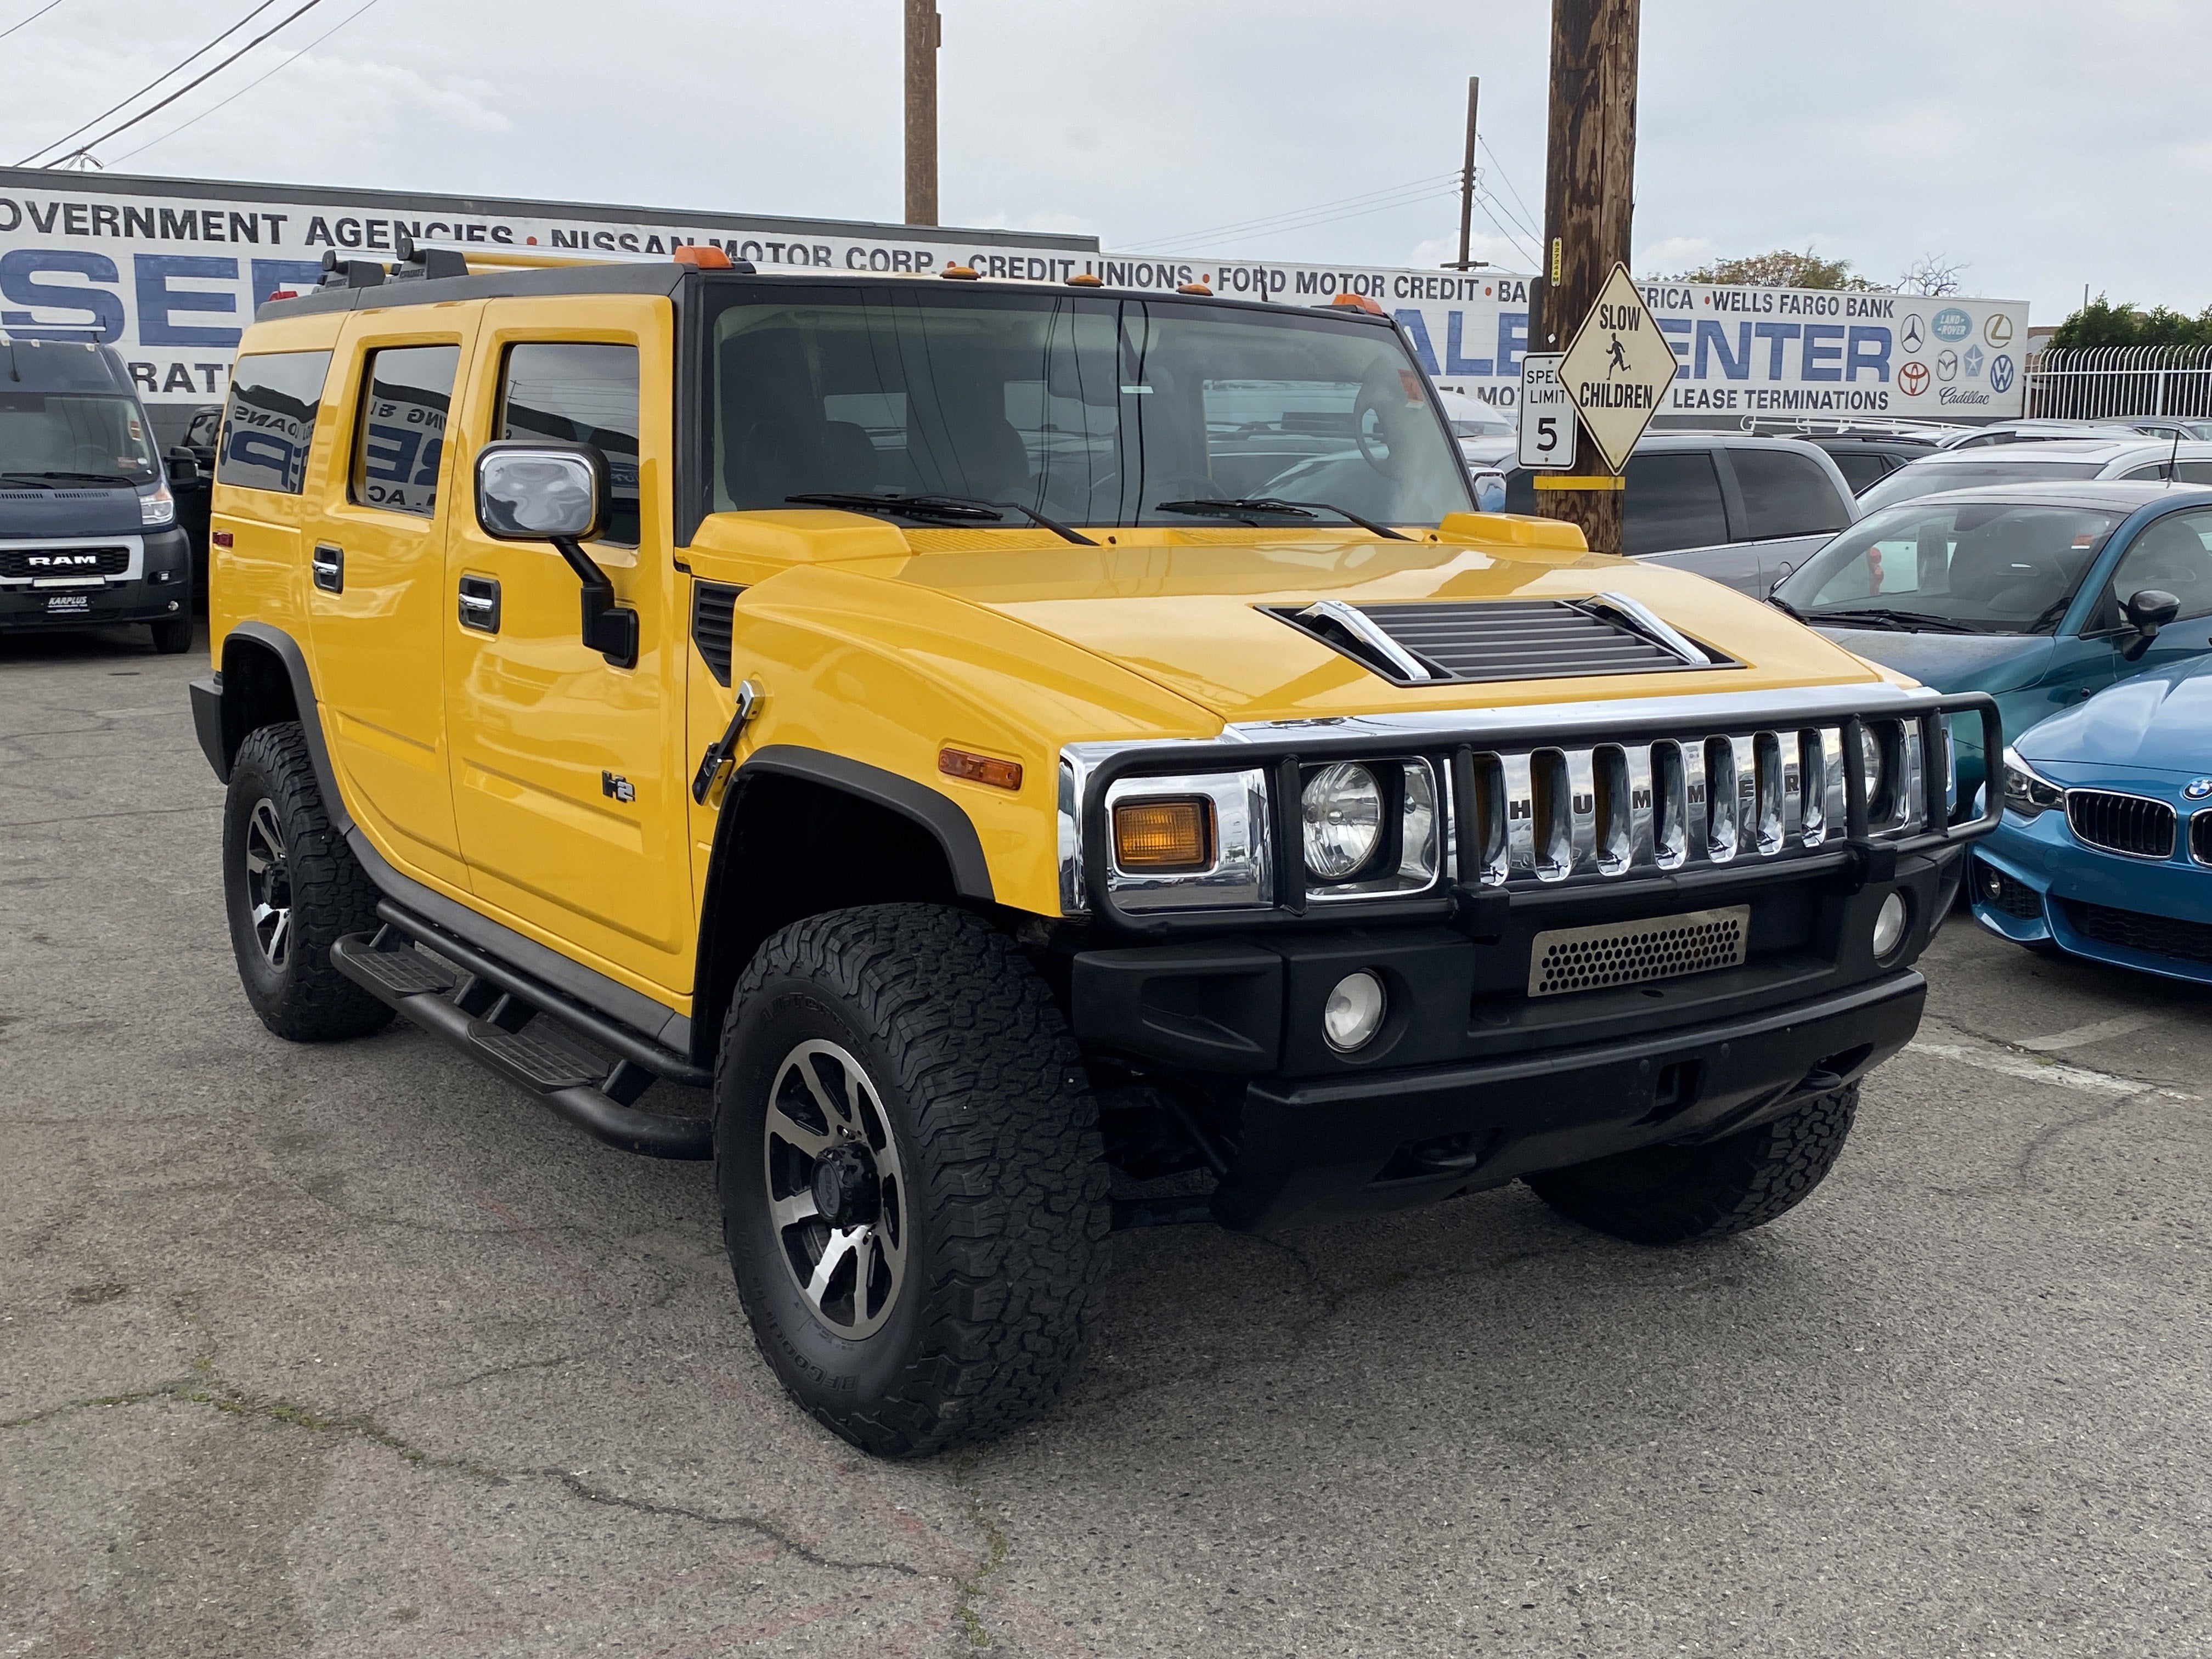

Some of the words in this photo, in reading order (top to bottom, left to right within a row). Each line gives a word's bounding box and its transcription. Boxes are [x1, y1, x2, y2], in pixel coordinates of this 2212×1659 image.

[551, 229, 695, 255] NISSAN
[968, 254, 1075, 284] CREDIT
[1086, 260, 1193, 289] UNIONS
[1218, 267, 1286, 293] FORD
[1295, 271, 1385, 297] MOTOR
[1393, 275, 1480, 301] CREDIT
[1713, 291, 1773, 313] WELLS
[1780, 294, 1839, 316] FARGO
[1846, 297, 1894, 319] BANK
[1599, 303, 1641, 331] SLOW
[1530, 390, 1565, 404] LIMIT
[1580, 381, 1653, 410] CHILDREN
[1673, 388, 1738, 409] LEASE
[1745, 390, 1889, 411] TERMINATIONS
[1939, 386, 1990, 405] Cadillac
[1536, 417, 1558, 451] 5
[29, 556, 96, 566] RAM
[48, 596, 88, 605] KARPLUS
[602, 770, 635, 803] H2
[1510, 774, 1799, 820] HUMMER
